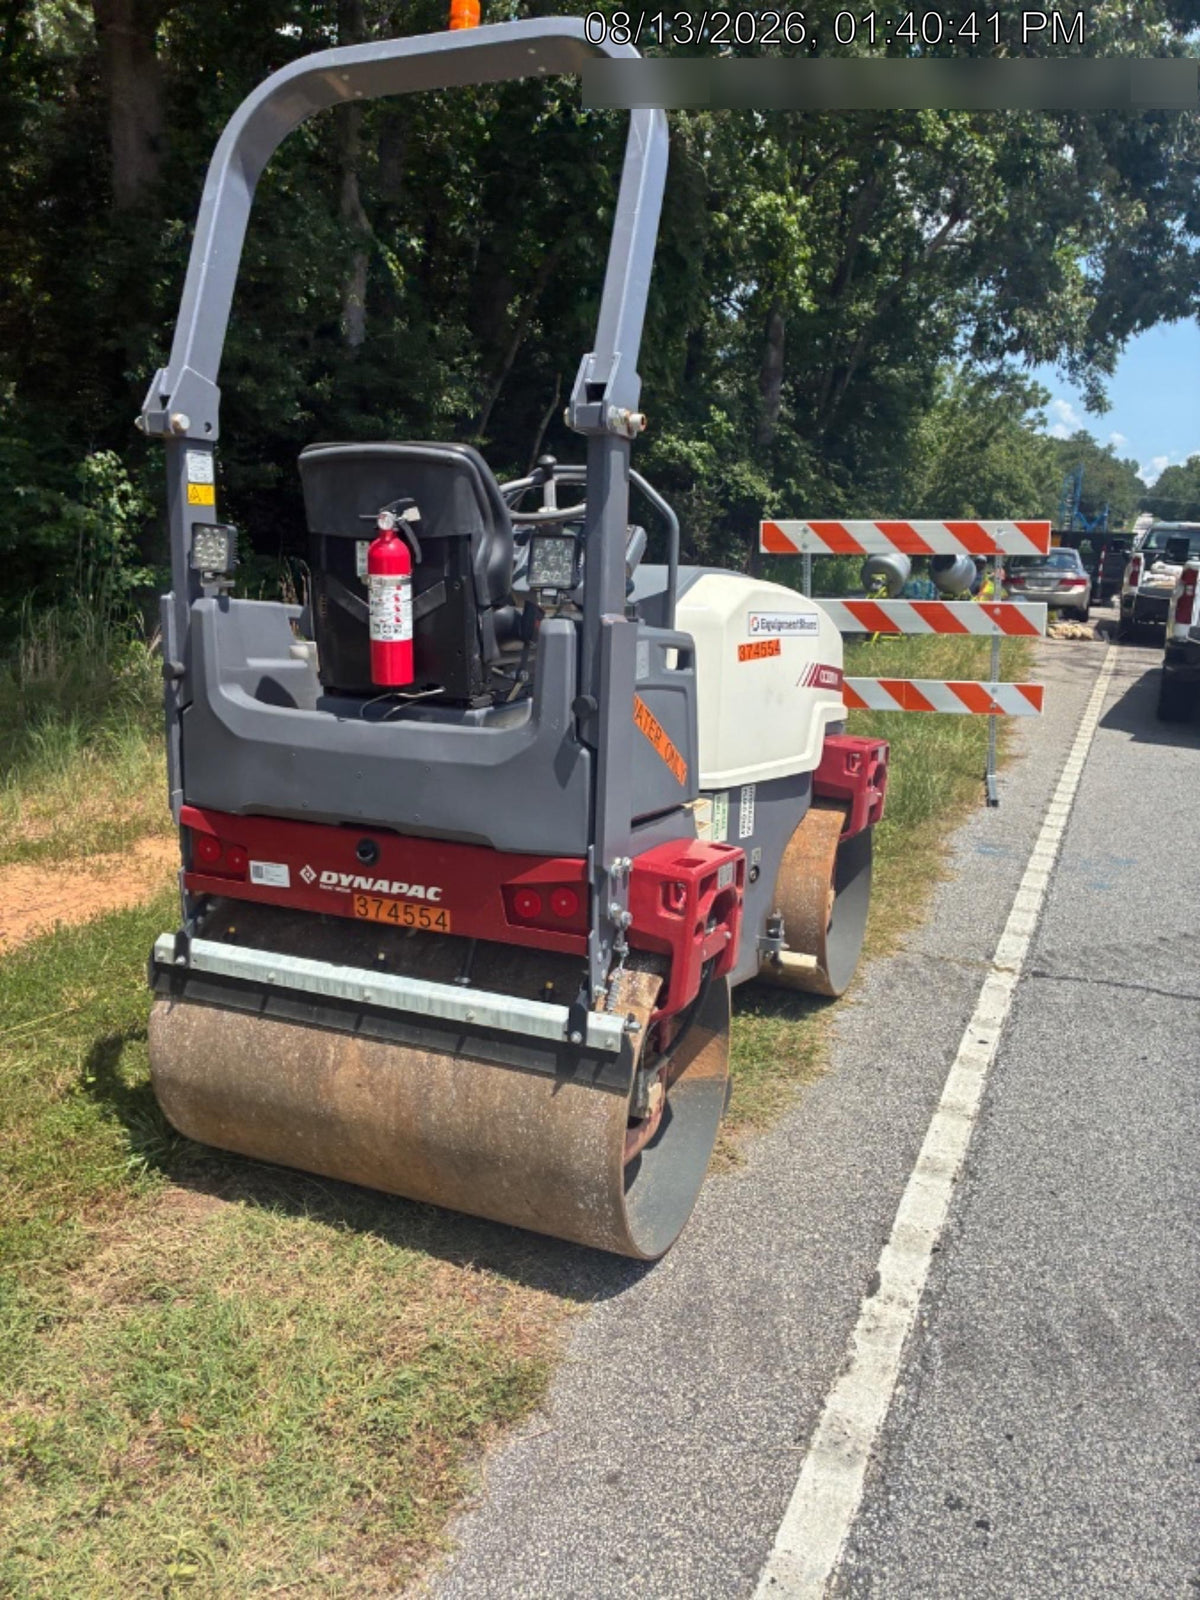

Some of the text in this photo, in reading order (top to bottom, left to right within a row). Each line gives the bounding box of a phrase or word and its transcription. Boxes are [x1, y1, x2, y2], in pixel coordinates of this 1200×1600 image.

[738, 640, 780, 661] 374554
[319, 869, 443, 901] DYNAPAC
[356, 895, 448, 931] 374554
